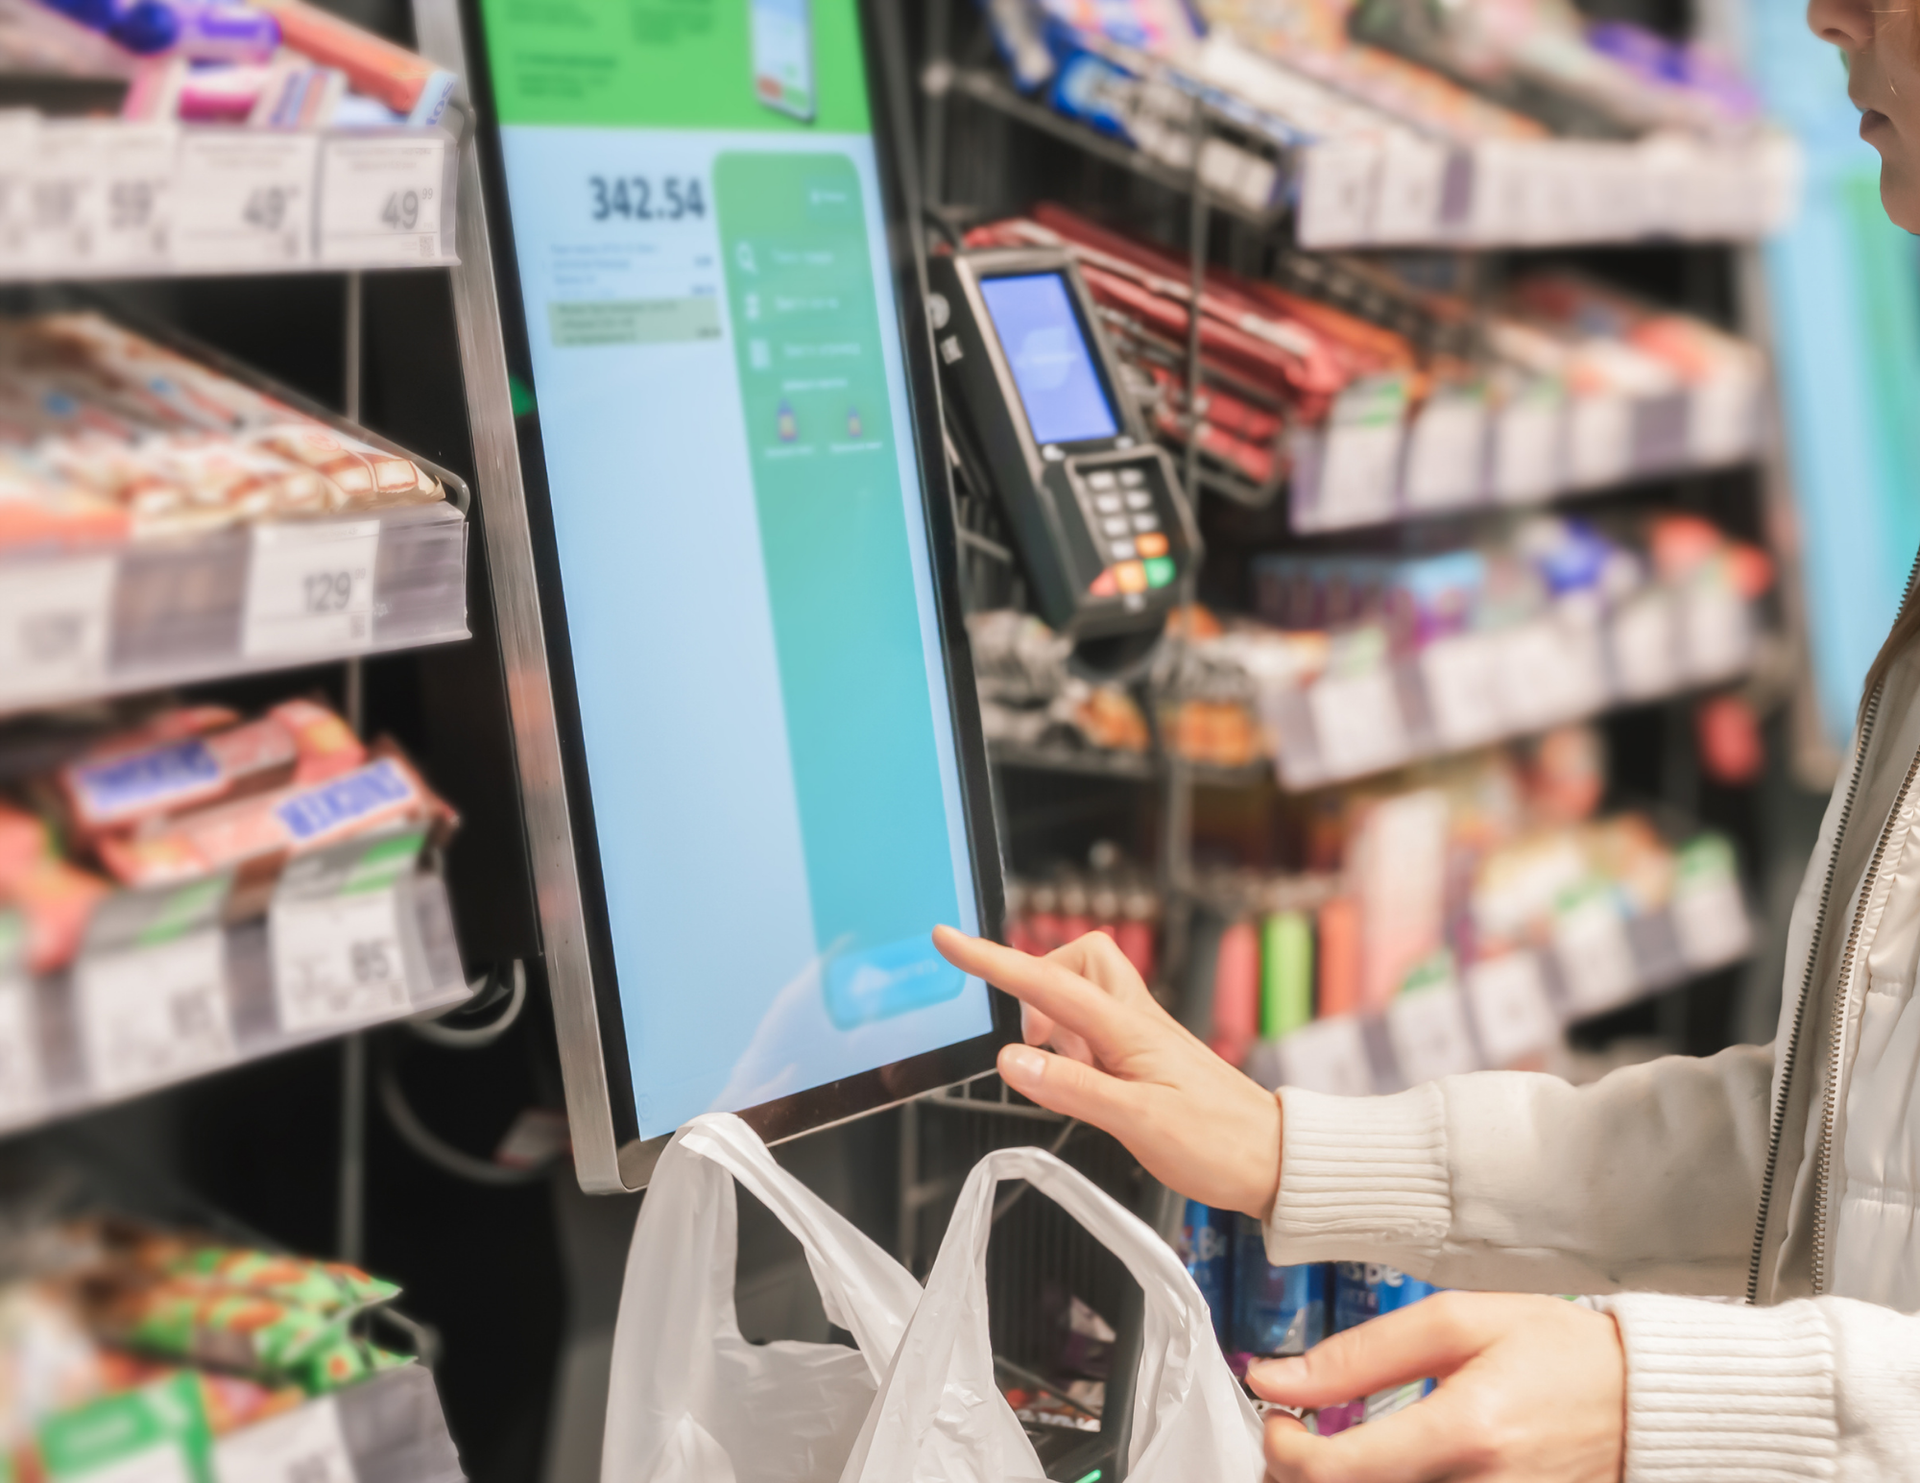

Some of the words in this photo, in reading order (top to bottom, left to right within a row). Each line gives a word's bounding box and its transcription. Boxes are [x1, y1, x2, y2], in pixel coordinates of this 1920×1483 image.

[381, 190, 419, 230] 49
[422, 187, 434, 200] 99
[589, 175, 705, 220] 342.54
[304, 571, 351, 622] 129
